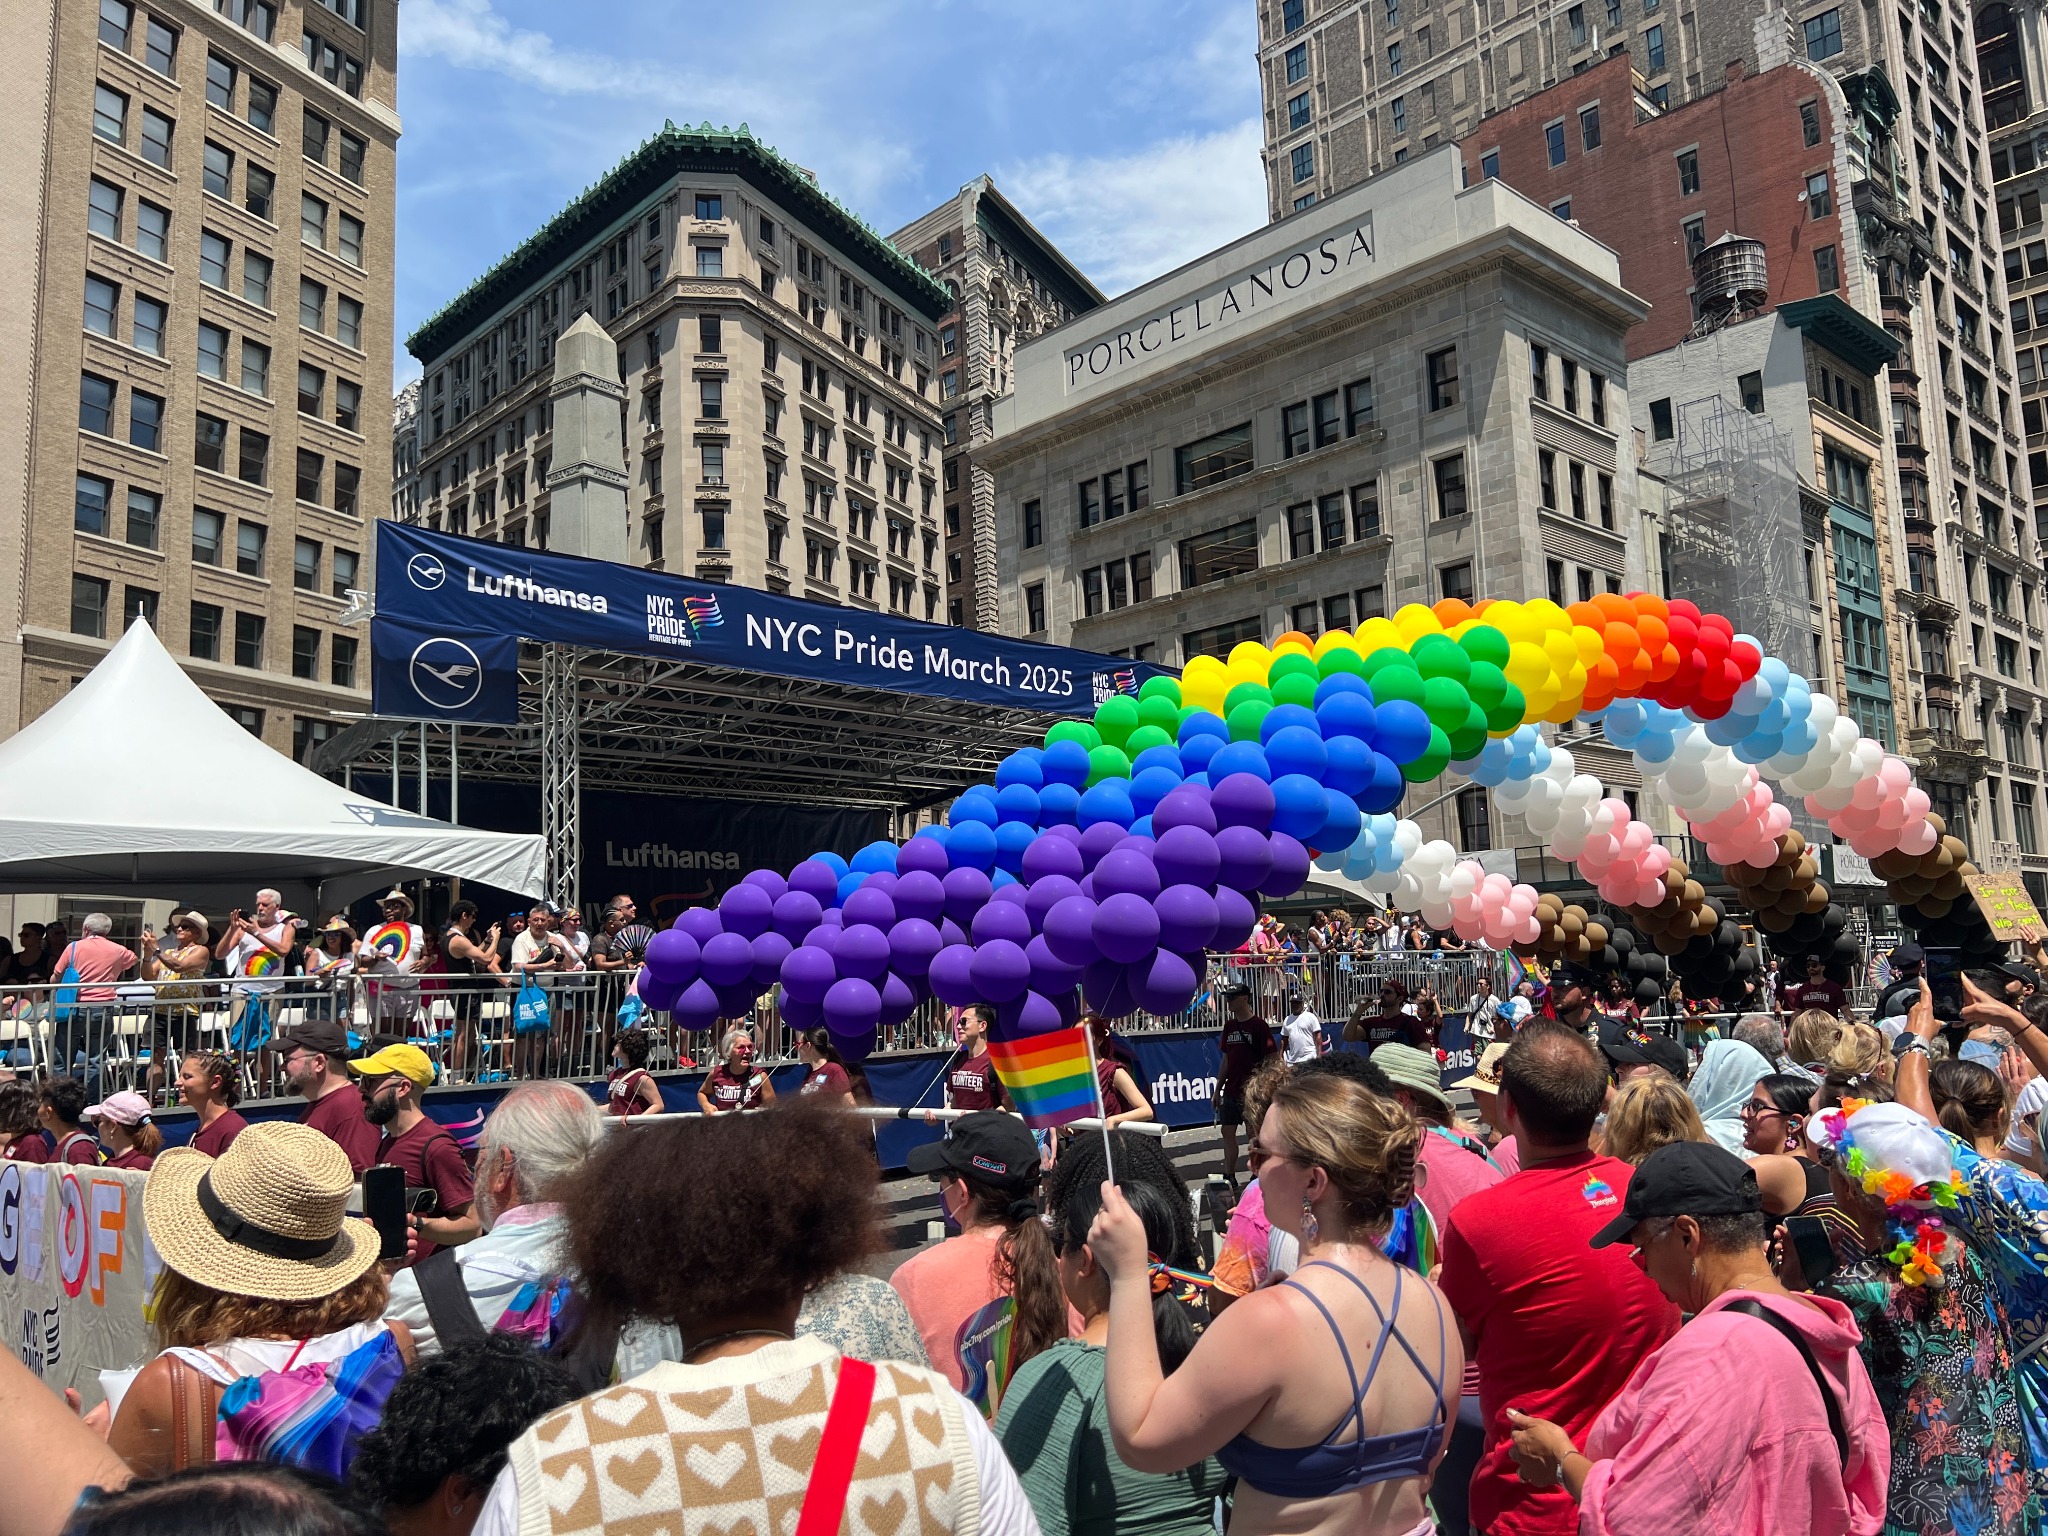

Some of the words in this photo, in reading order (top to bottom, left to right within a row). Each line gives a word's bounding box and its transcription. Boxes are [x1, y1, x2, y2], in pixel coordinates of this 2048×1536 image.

[1069, 228, 1372, 386] PORCELANOSA
[467, 566, 608, 615] Lufthansa
[646, 594, 674, 617] NYC
[647, 614, 687, 639] PRIDE
[746, 613, 822, 657] NYC
[834, 630, 914, 671] Pride
[924, 644, 1011, 687] March
[1019, 662, 1073, 697] 2025
[1092, 671, 1109, 689] NYC
[605, 840, 740, 870] Lufthansa
[1840, 854, 1869, 870] PORCELA
[58, 1173, 127, 1307] OF
[23, 1308, 38, 1348] NYC
